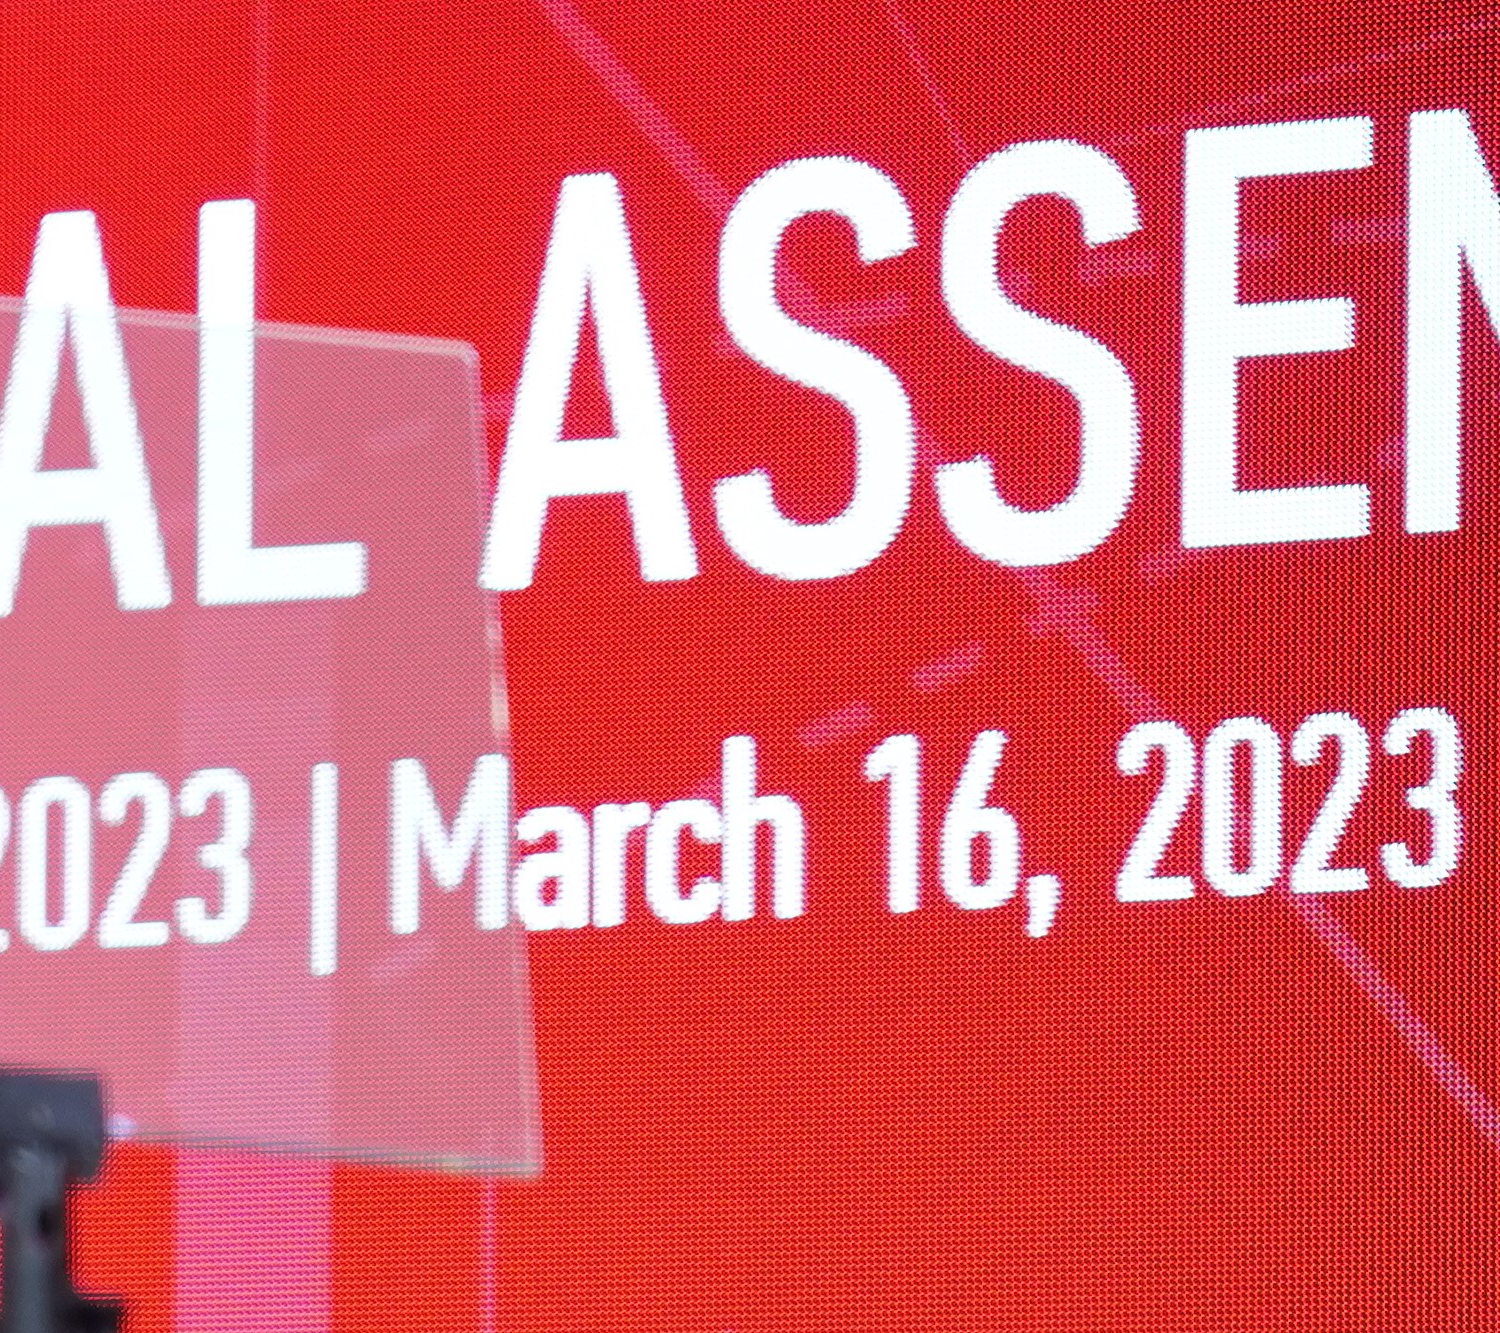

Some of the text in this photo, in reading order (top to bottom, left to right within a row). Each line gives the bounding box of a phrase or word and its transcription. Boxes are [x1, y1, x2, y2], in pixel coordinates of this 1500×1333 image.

[389, 736, 804, 936] March
[866, 731, 1058, 937] 16,
[1117, 708, 1460, 902] 2023
